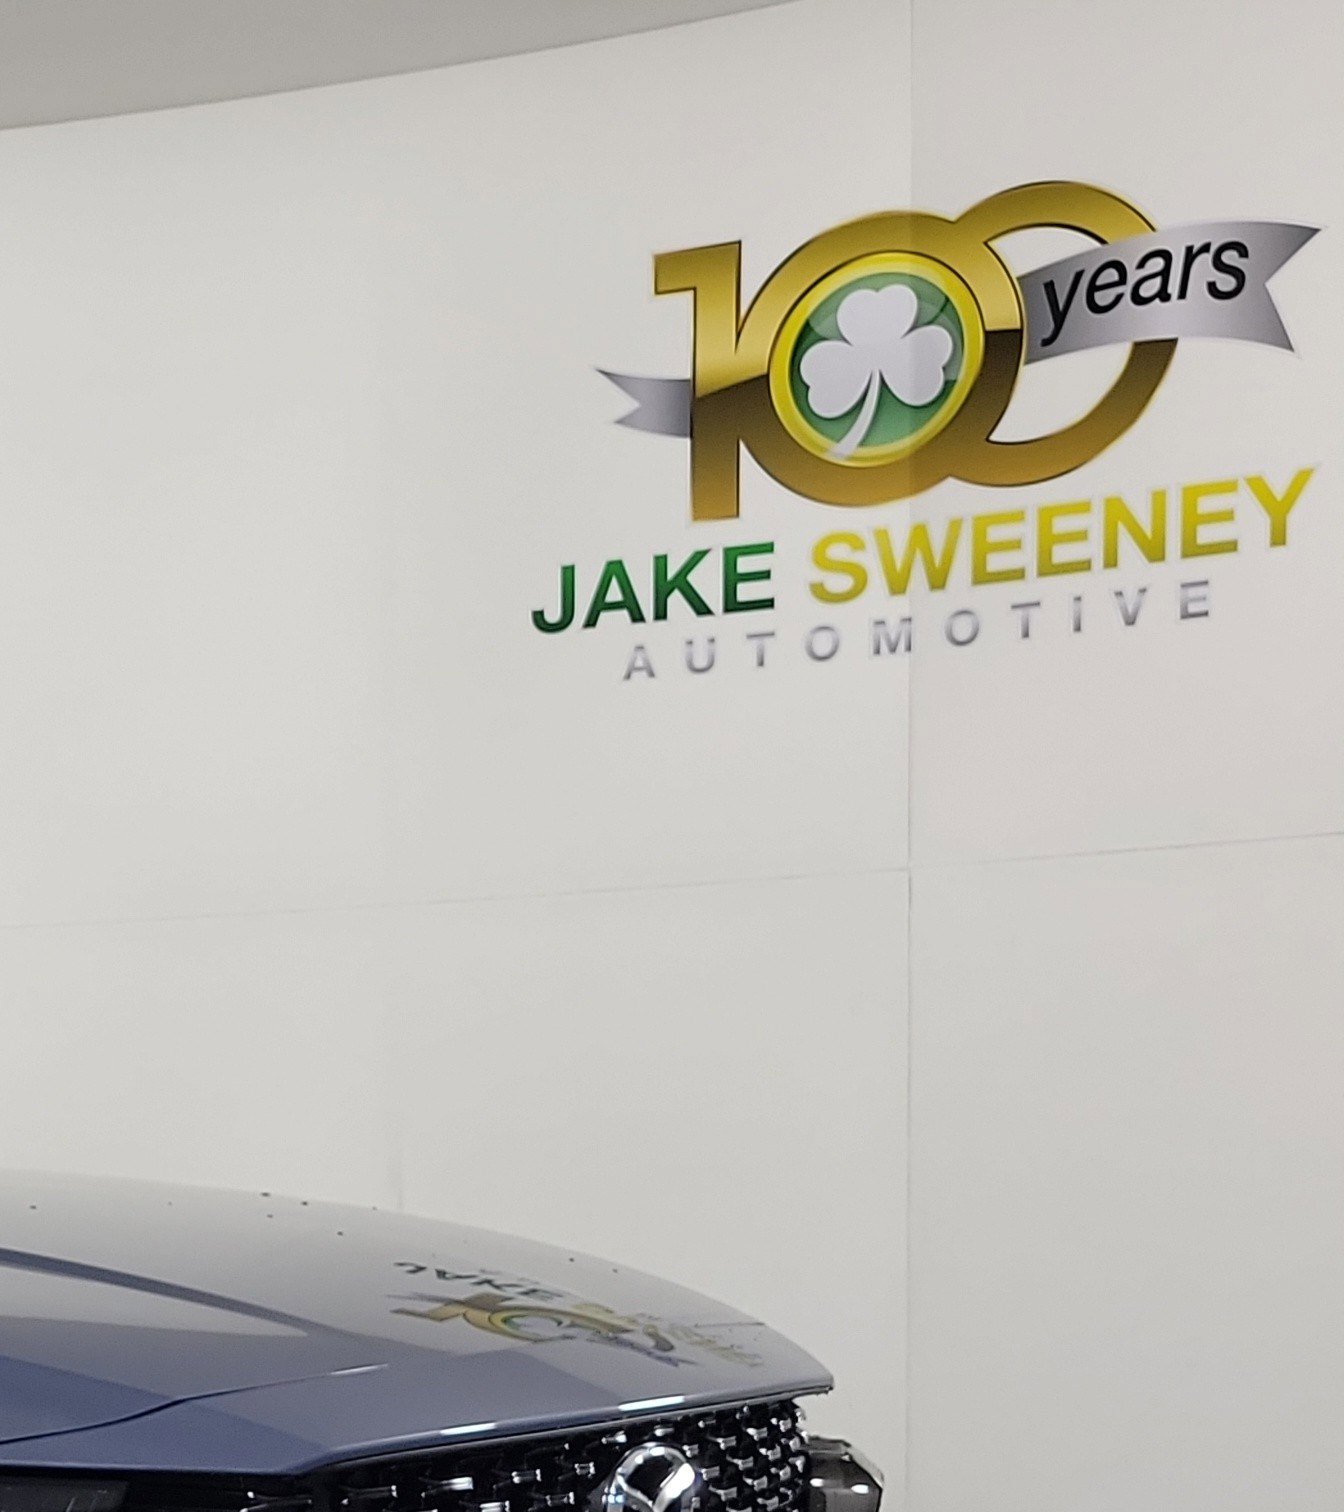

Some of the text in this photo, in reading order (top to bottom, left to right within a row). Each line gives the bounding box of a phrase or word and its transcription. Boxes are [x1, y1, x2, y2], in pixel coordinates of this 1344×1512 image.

[1041, 240, 1249, 345] years
[531, 466, 1316, 634] JAKE SWEENEY
[622, 580, 1213, 683] AUTOMOTIVE
